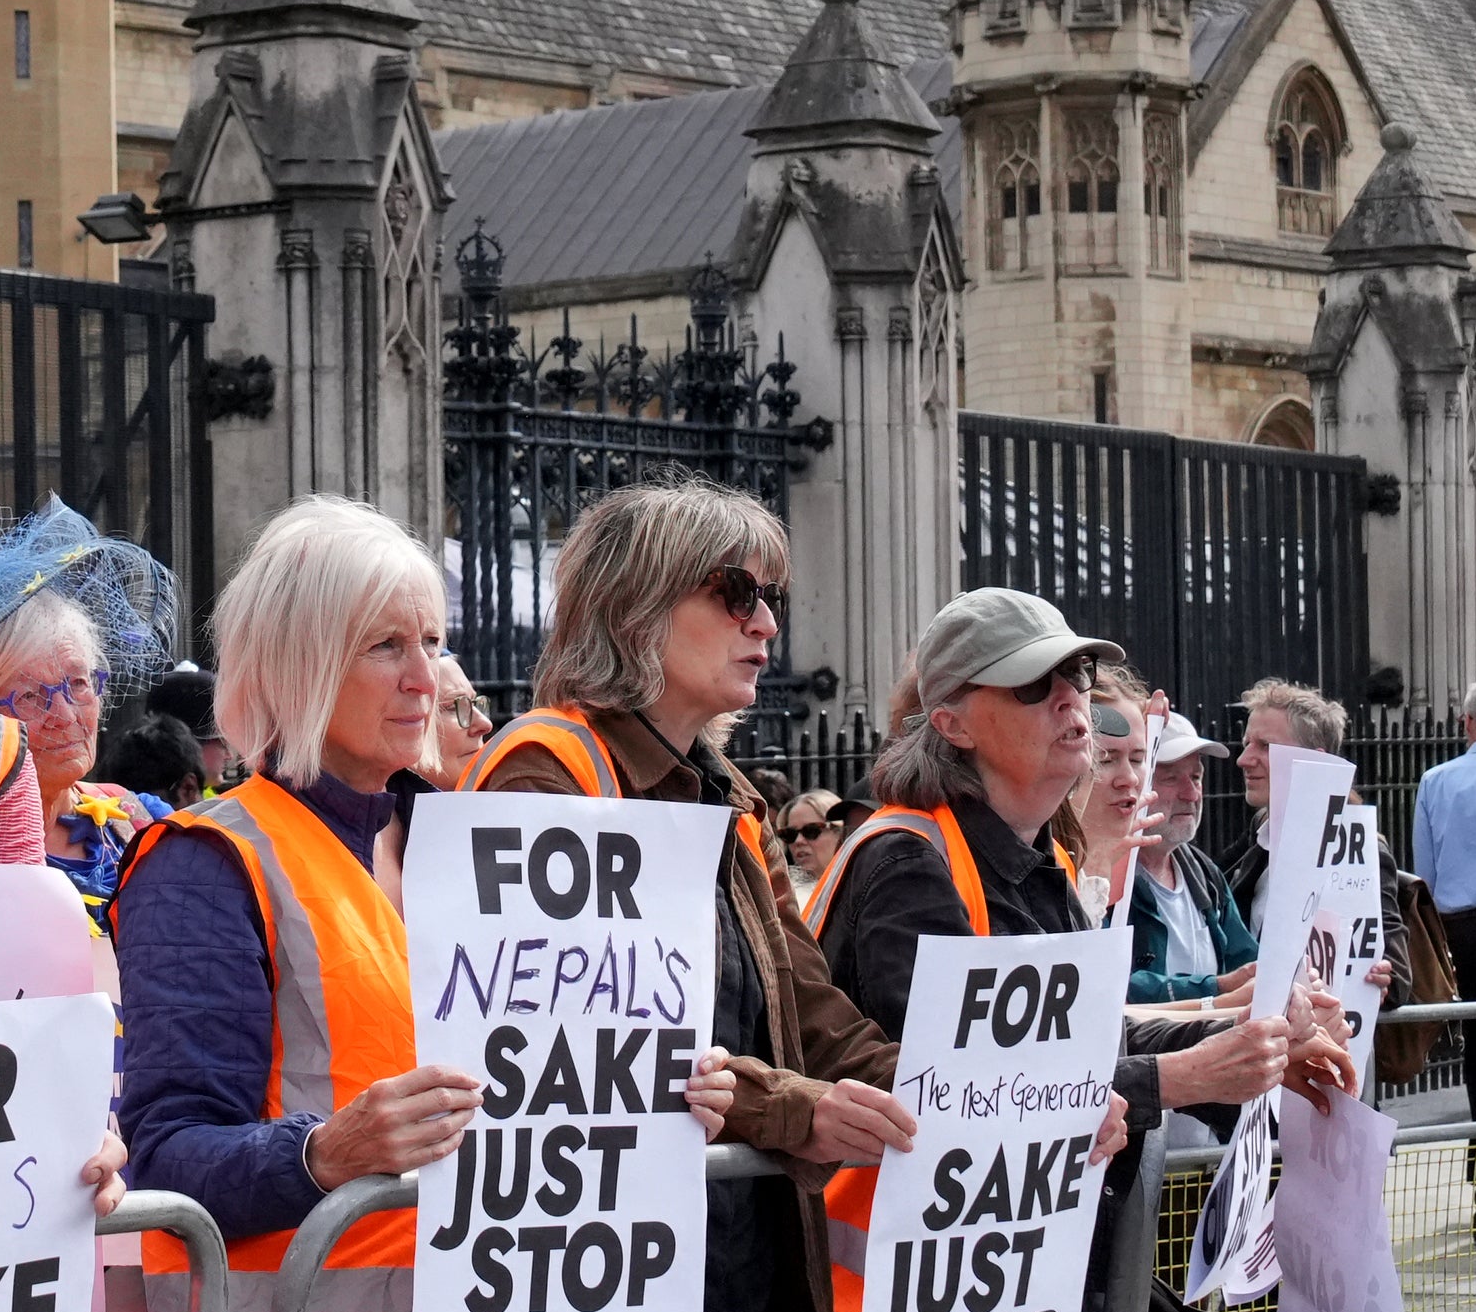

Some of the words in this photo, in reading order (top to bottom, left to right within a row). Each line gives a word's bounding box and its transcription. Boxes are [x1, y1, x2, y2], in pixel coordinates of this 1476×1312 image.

[471, 826, 643, 920] FOR
[434, 935, 692, 1026] NEPAL'S
[953, 962, 1080, 1050] FOR
[482, 1024, 697, 1121] SAKE
[900, 1066, 952, 1116] The
[432, 1124, 637, 1250] JUST
[921, 1132, 1093, 1232] SAKE
